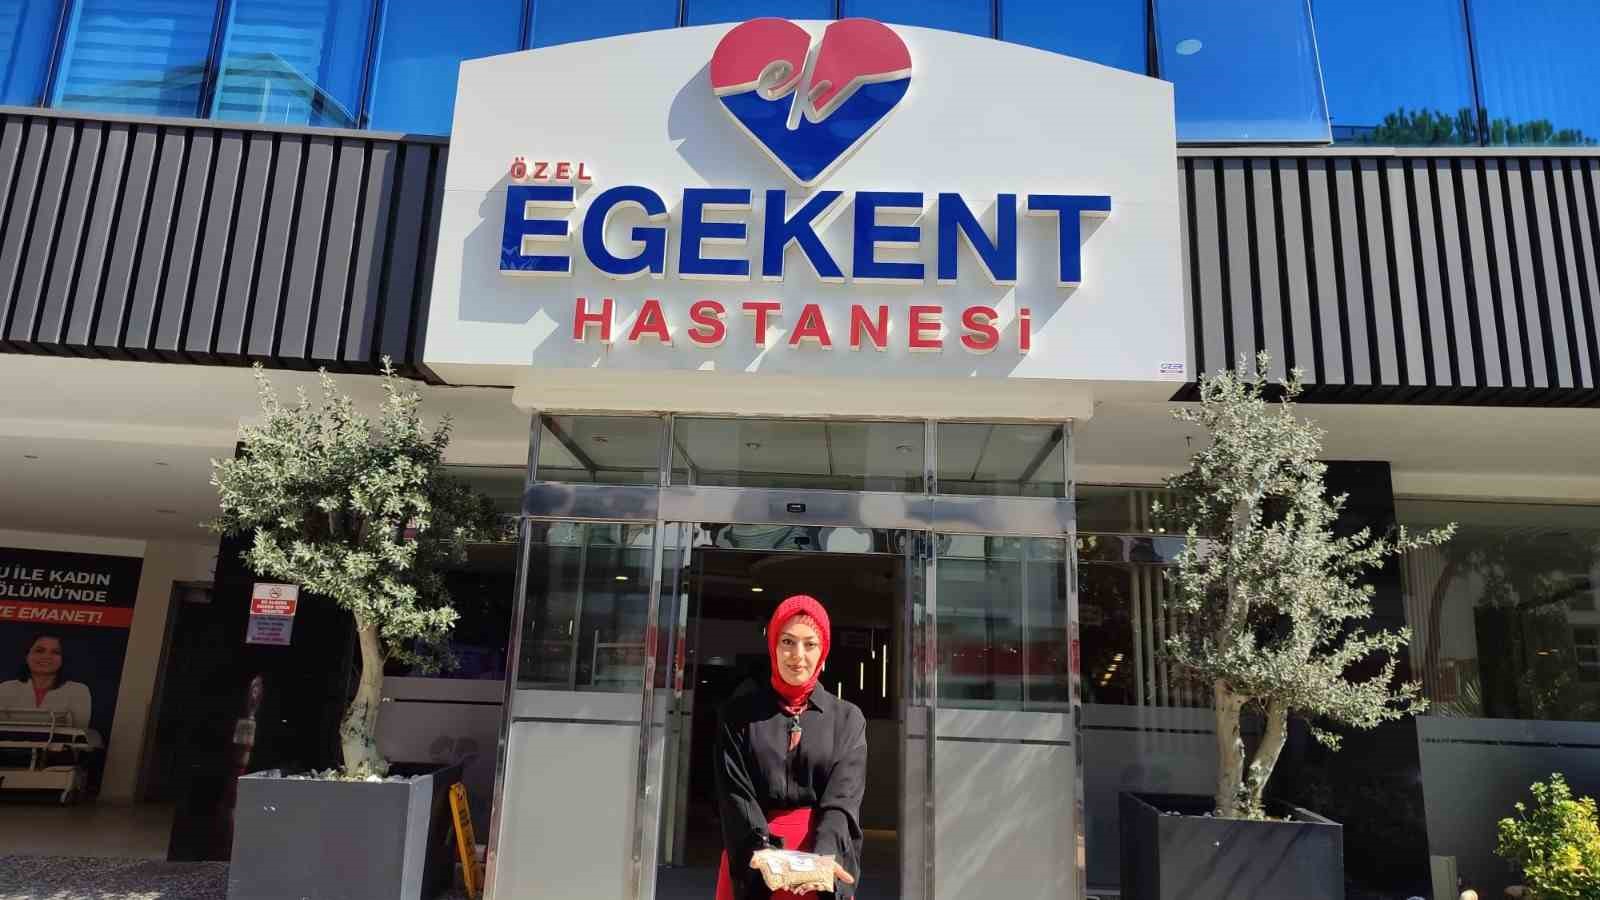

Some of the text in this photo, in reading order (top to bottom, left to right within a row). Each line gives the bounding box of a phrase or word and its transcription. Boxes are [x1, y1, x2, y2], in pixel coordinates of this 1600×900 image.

[510, 157, 591, 180] ÖZEL
[500, 185, 1111, 284] EGEKENT
[14, 564, 45, 581] İLE
[49, 570, 111, 586] KADIN
[18, 607, 104, 624] EMANET!
